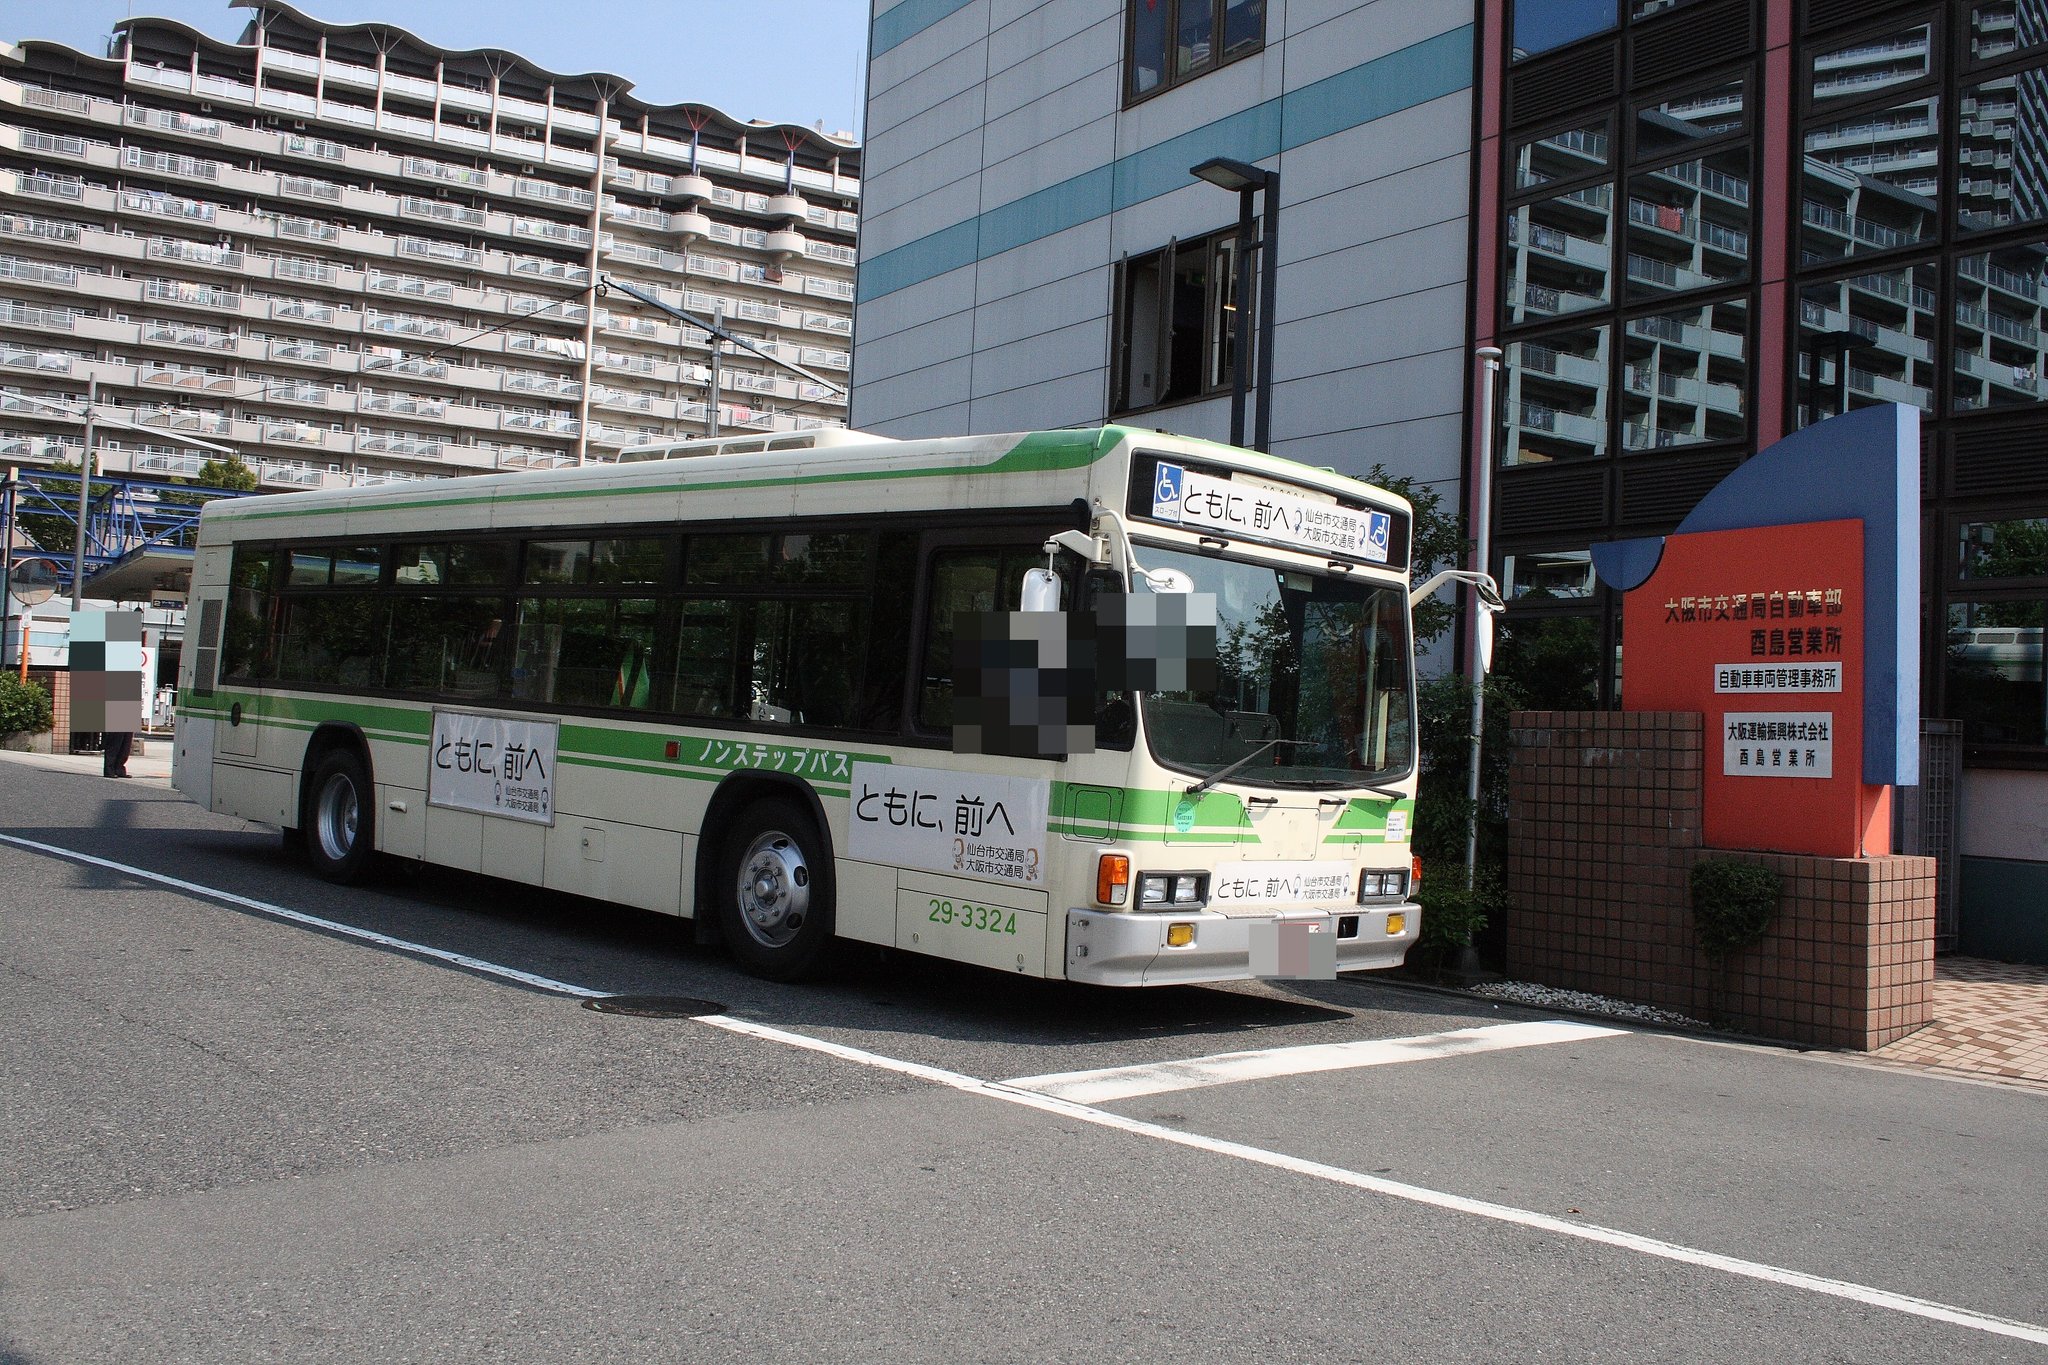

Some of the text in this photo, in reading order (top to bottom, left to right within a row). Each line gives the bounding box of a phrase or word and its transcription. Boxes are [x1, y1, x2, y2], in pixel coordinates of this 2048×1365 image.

[1305, 508, 1357, 534] 仙台市交通局
[1303, 526, 1355, 550] 大阪市交通局
[1665, 588, 1843, 624] 大阪市交通局自動車部
[1719, 668, 1837, 689] 自動車車両管理事務所
[1728, 722, 1829, 741] 大阪運輸振興株式会社
[699, 738, 849, 777] ノンステップバス
[505, 785, 540, 801] 仙台市交通局
[504, 798, 540, 813] 大阪市交通局
[966, 842, 1025, 863] 仙台市交通局
[965, 860, 1024, 879] 大阪市交通局
[1304, 875, 1343, 888] 仙台市交通局
[1302, 888, 1341, 900] 大阪市交通局
[928, 899, 1017, 935] 29-3324
